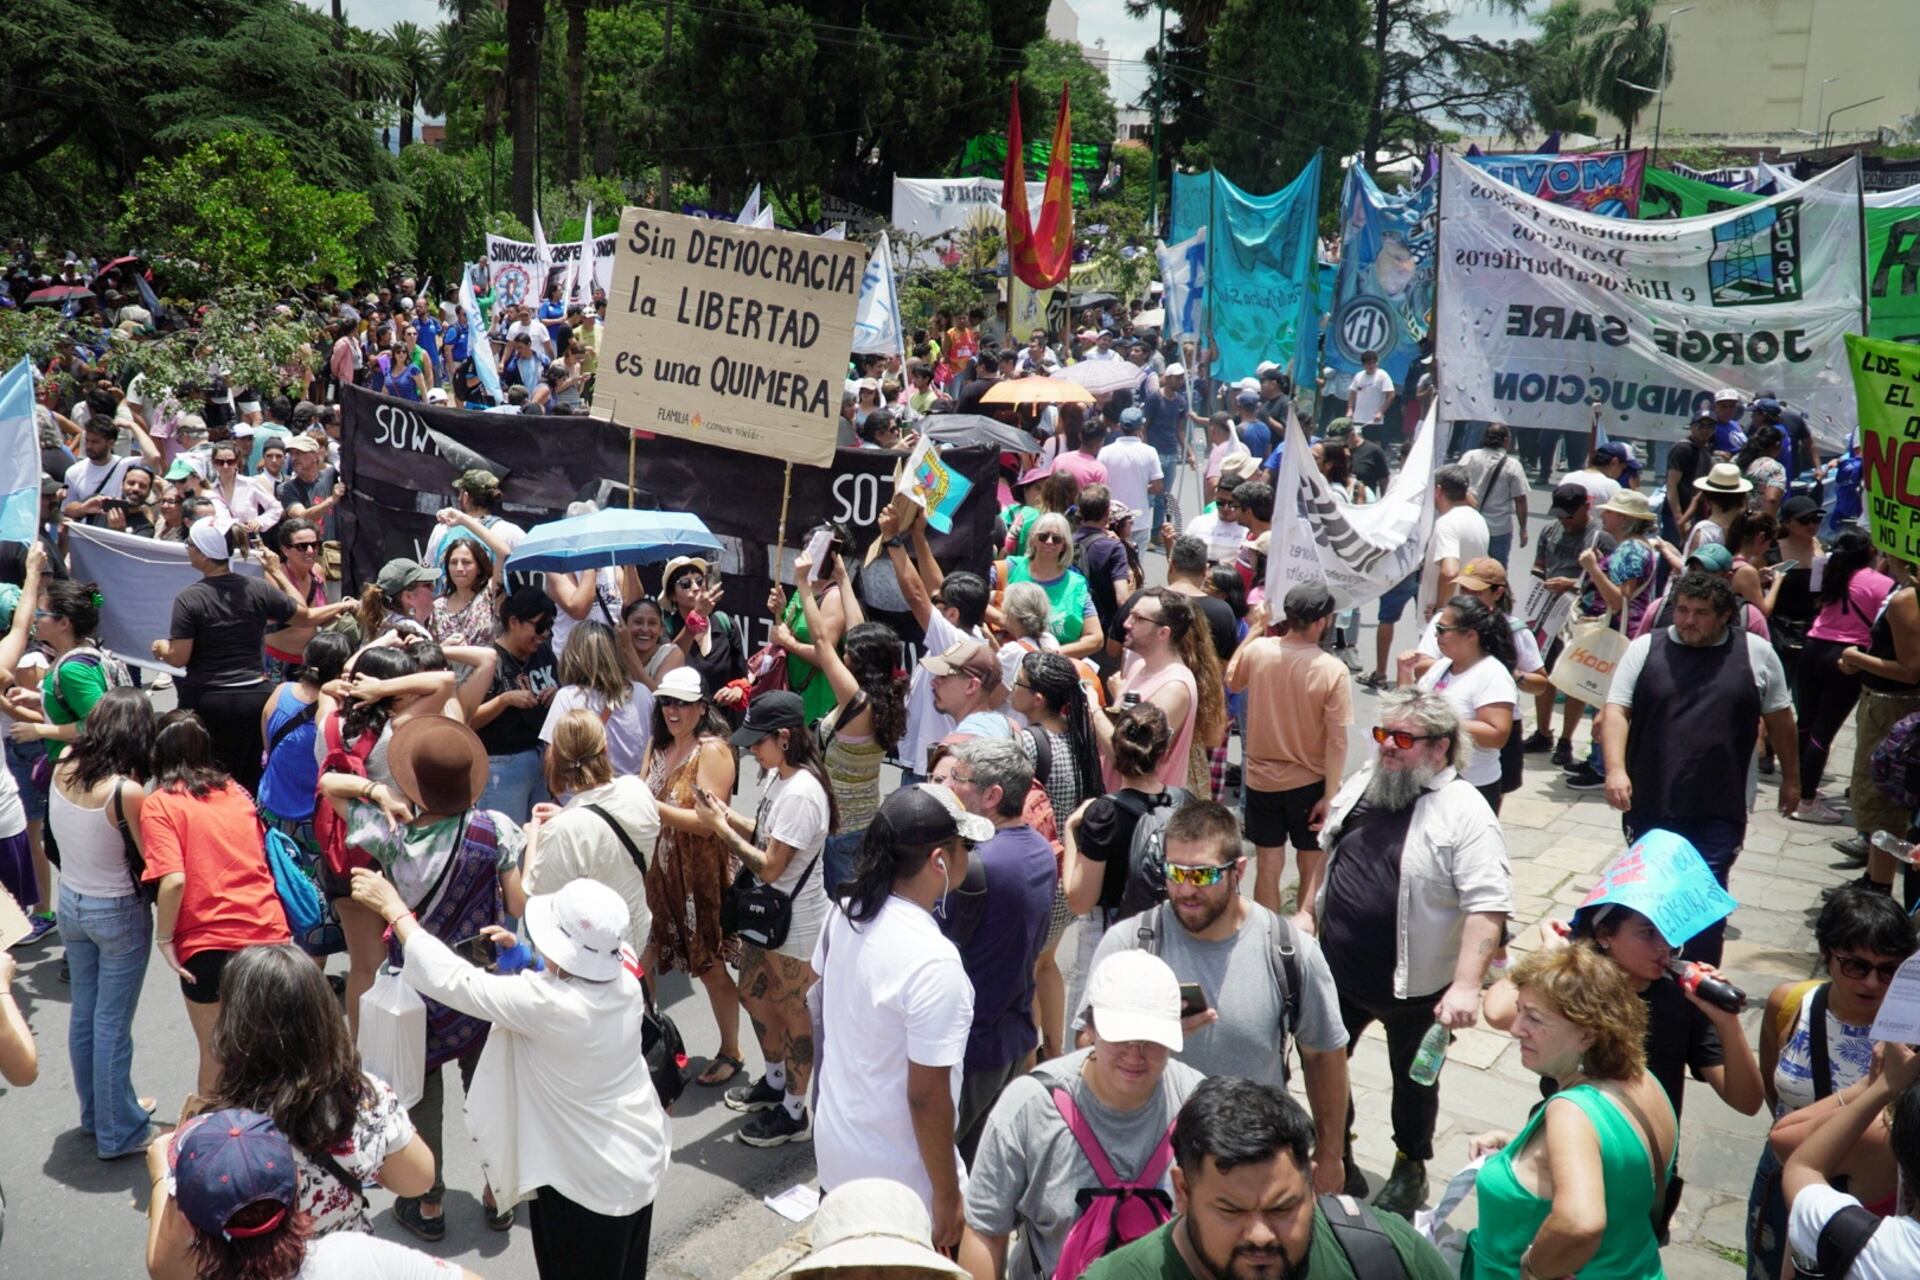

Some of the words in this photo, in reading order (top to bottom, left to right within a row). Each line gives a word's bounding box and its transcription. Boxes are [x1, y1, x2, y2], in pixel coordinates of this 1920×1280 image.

[941, 185, 1004, 205] FREN
[490, 242, 542, 264] SINDICA
[628, 220, 676, 260] Sin
[687, 229, 857, 294] DEMOCRACIA
[628, 275, 656, 317] la
[677, 286, 820, 349] LIBERTAD
[1862, 351, 1901, 376] LOS
[615, 351, 643, 377] es
[654, 358, 701, 387] una
[710, 356, 830, 418] QUIMERA
[1884, 383, 1914, 408] EL
[1873, 496, 1900, 525] QUE
[1879, 525, 1896, 548] NO
